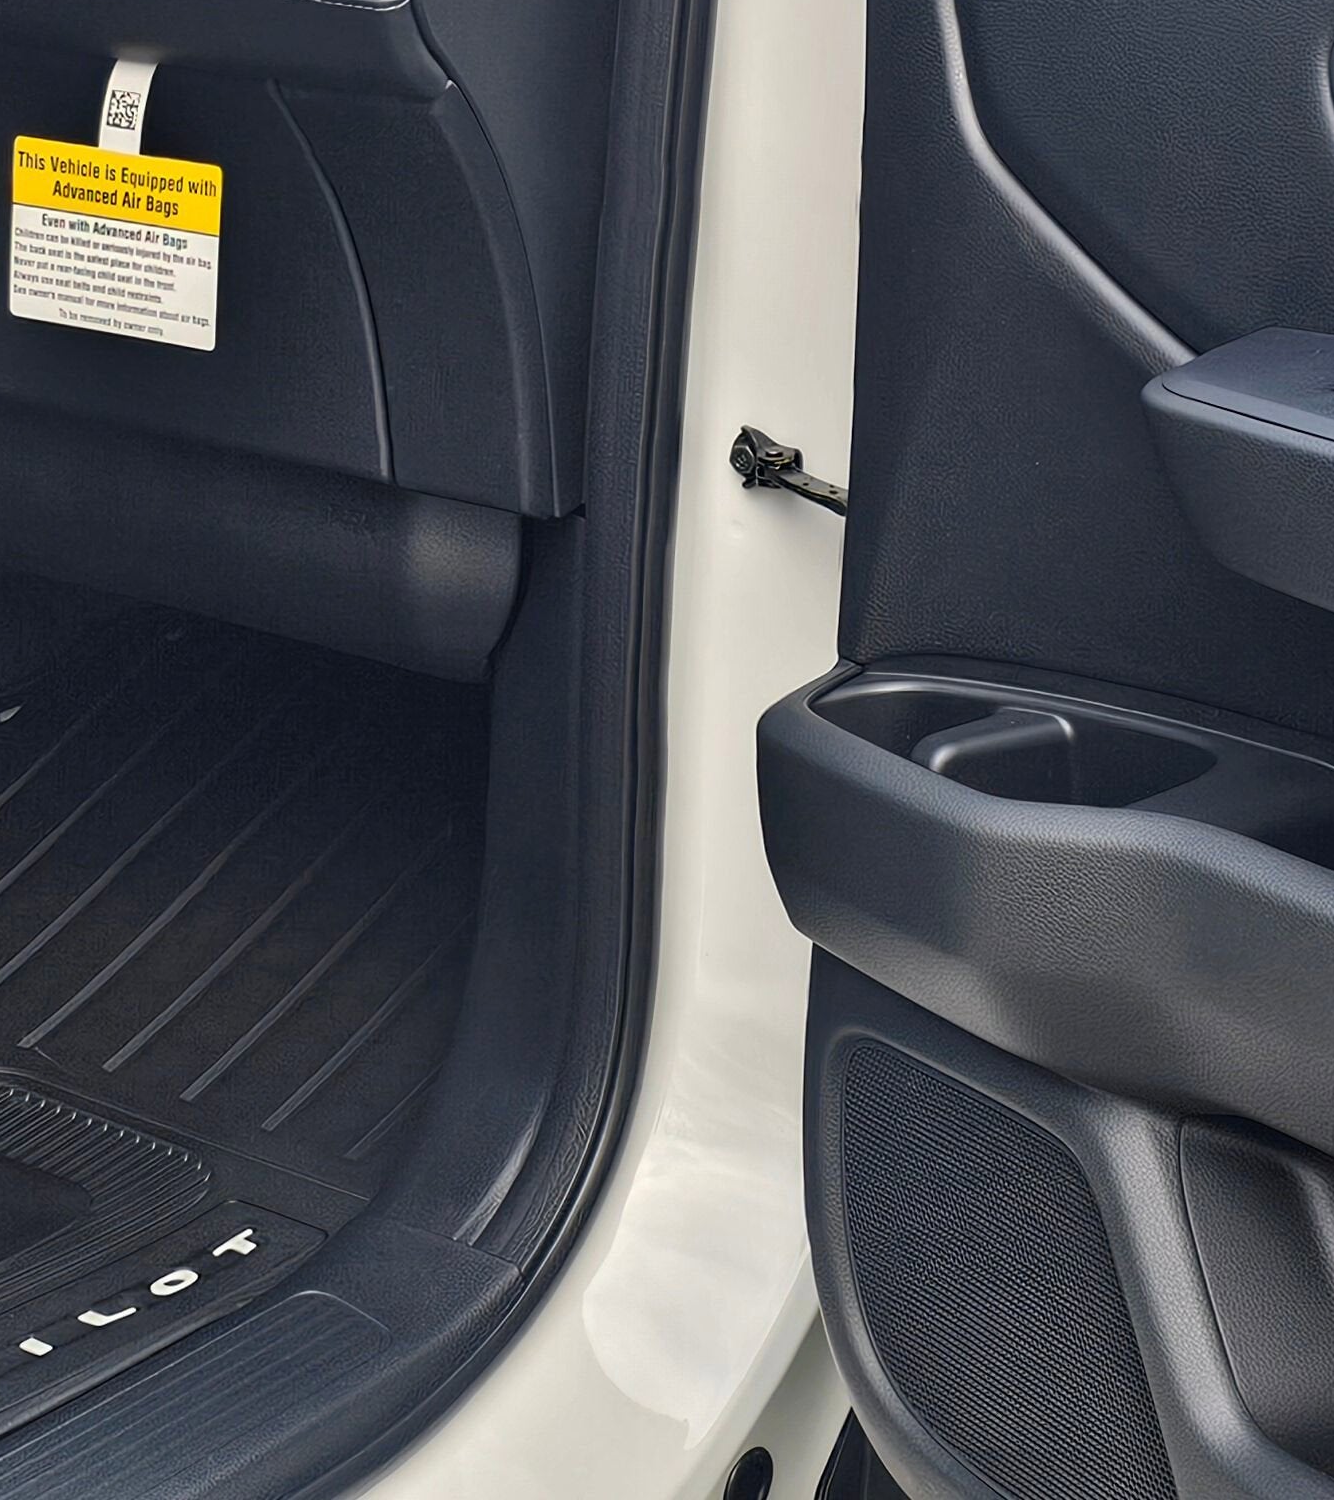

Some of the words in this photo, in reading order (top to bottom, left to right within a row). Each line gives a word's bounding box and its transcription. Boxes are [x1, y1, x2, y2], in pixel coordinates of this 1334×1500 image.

[18, 151, 45, 170] This
[50, 156, 99, 178] Vehicle
[105, 164, 116, 181] is
[121, 167, 183, 193] Equipped
[188, 179, 217, 197] with
[52, 180, 117, 205] Advanced
[122, 191, 141, 209] Air
[146, 195, 179, 218] Bags
[42, 213, 65, 229] Even
[68, 219, 90, 233] with
[93, 222, 142, 241] Advanced
[144, 231, 160, 244] Air
[163, 233, 188, 251] Bags
